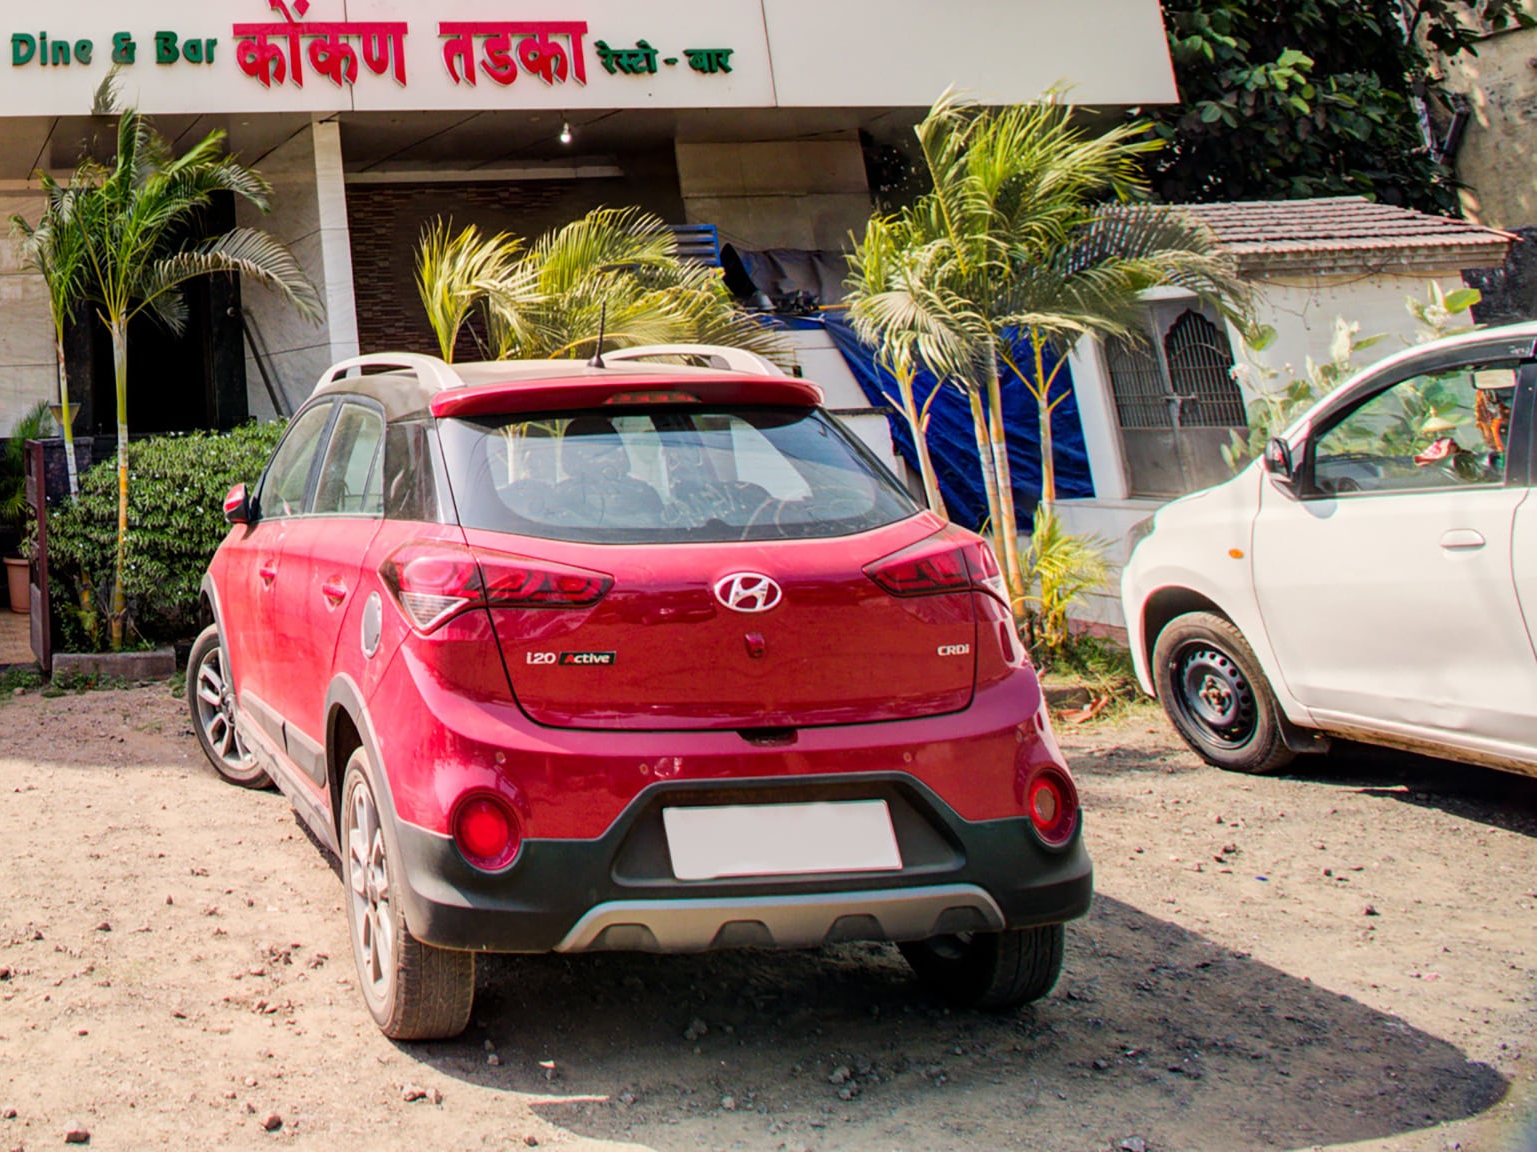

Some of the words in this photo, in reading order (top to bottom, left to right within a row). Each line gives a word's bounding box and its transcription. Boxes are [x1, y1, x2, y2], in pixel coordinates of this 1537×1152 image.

[11, 31, 94, 67] Dine
[112, 31, 137, 66] &
[154, 31, 219, 66] Bar
[437, 21, 588, 88] तडका
[594, 39, 659, 75] रेस्टो
[683, 48, 735, 75] बार
[564, 653, 610, 664] Active
